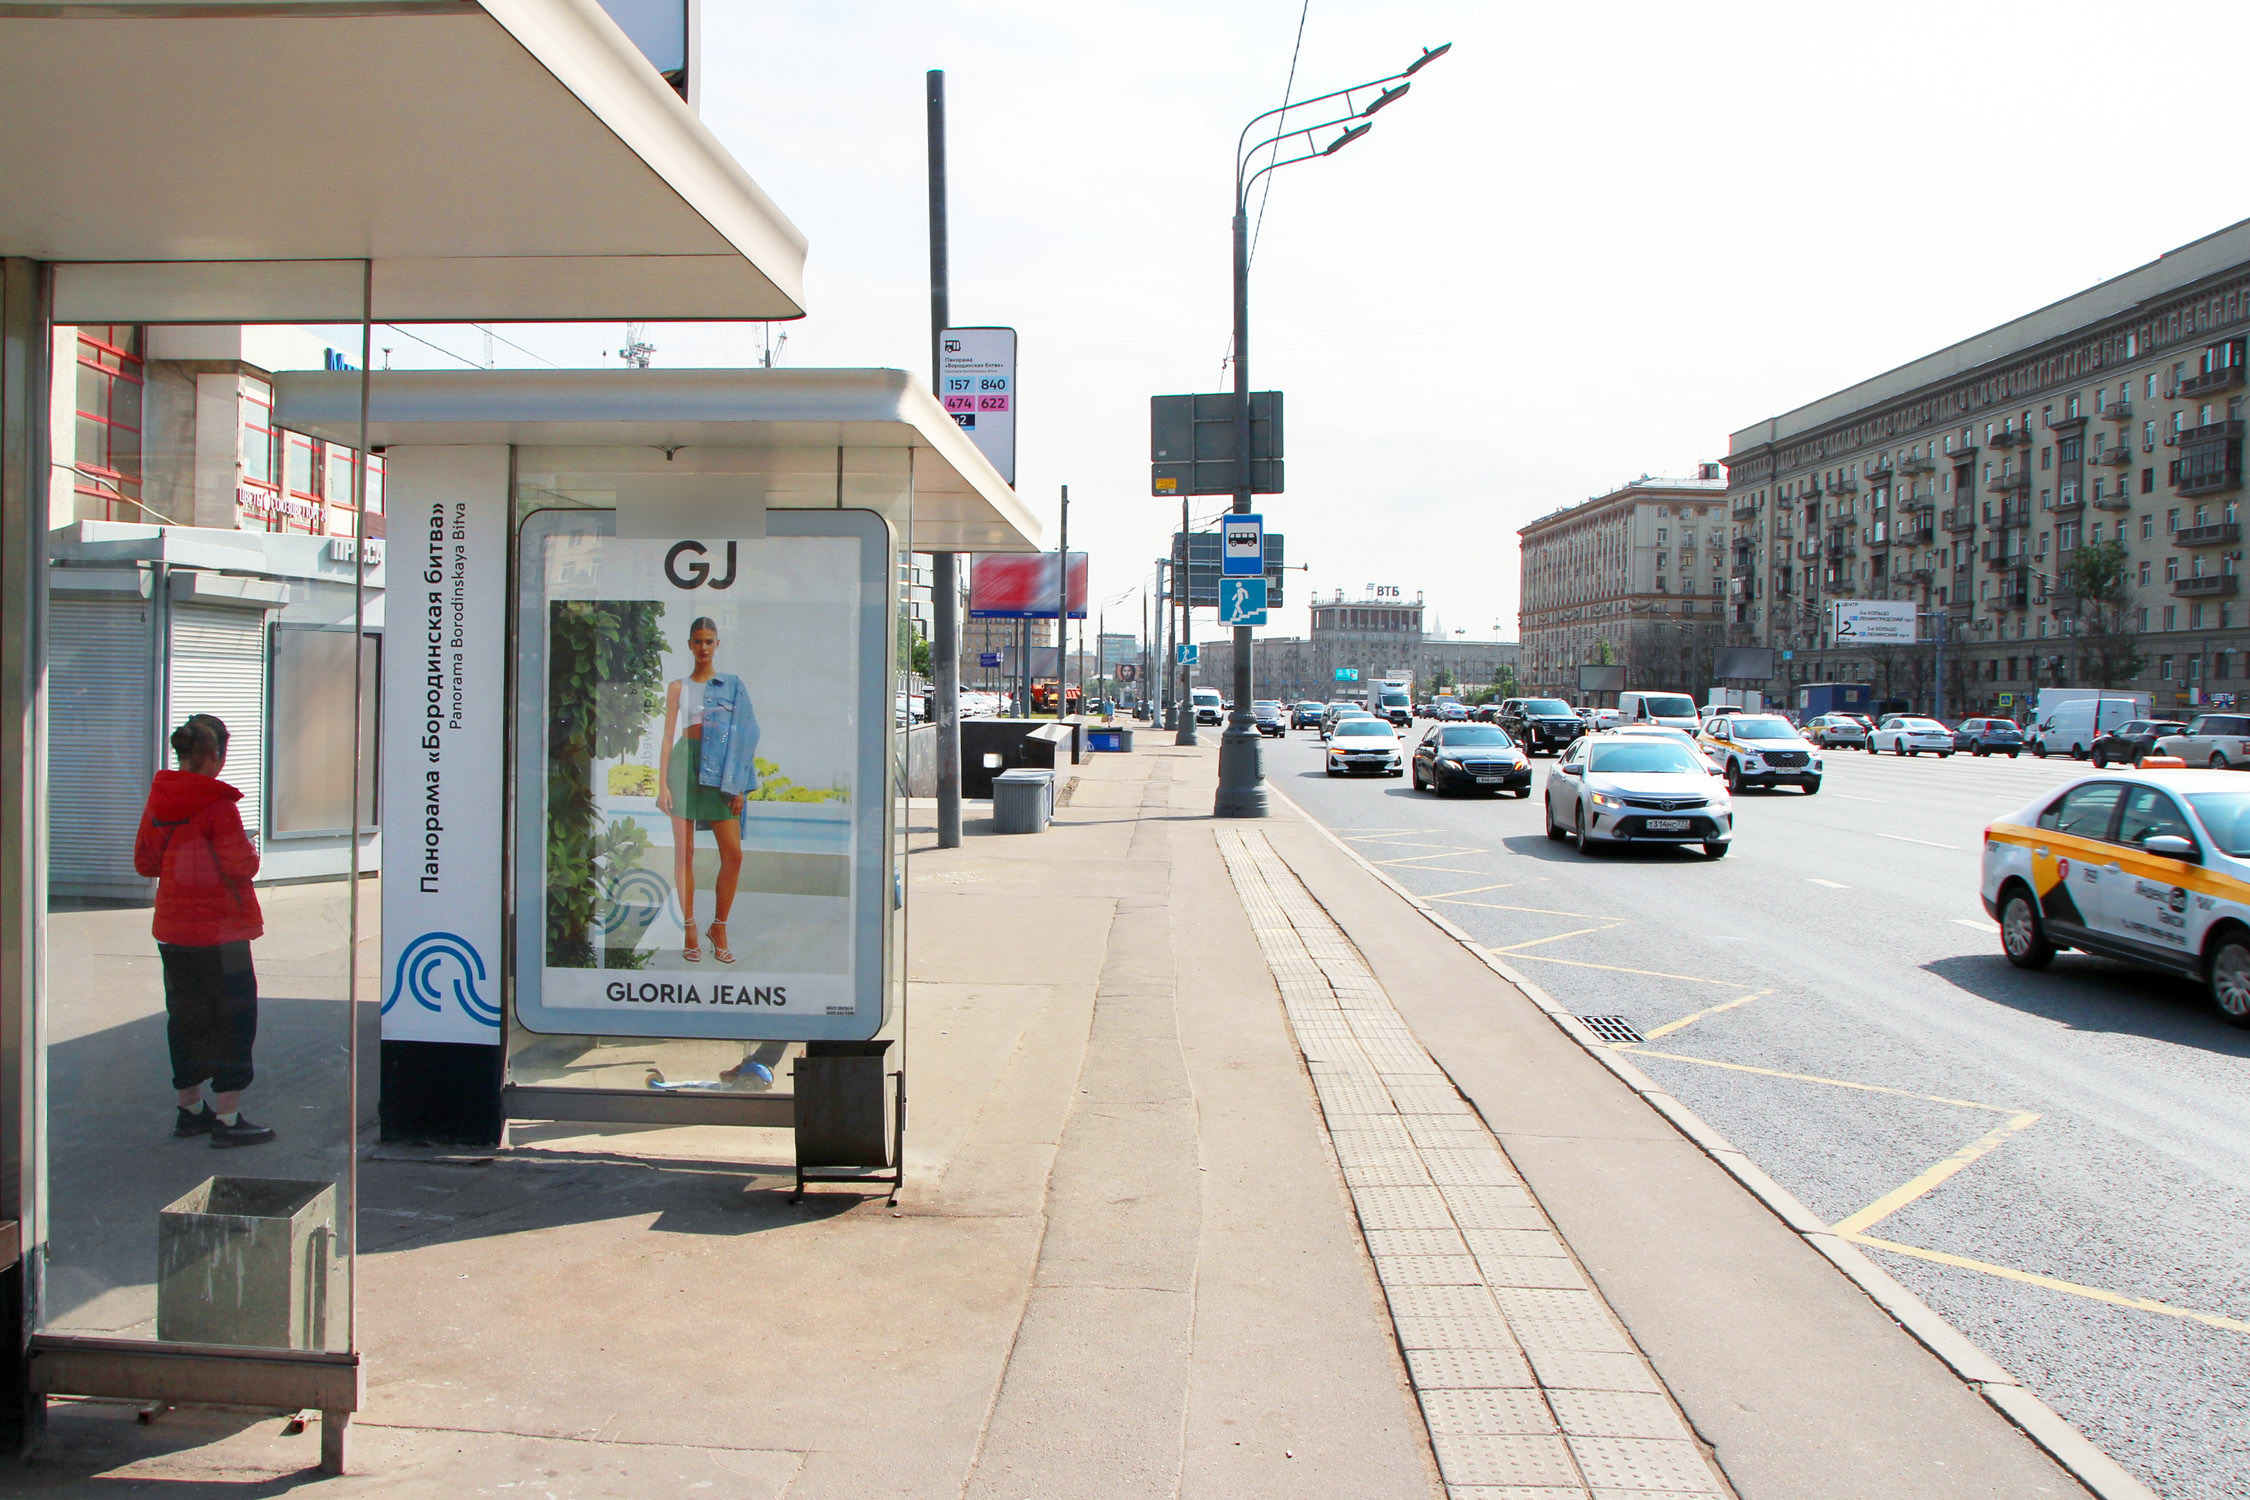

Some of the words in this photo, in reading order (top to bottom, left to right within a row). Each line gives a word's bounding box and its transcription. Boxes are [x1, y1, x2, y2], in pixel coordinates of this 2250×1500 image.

[948, 398, 972, 409] 474
[981, 398, 1005, 409] 622
[949, 379, 970, 391] 157
[981, 379, 1006, 390] 840
[237, 488, 263, 507] ЦВЕТЫ
[452, 502, 466, 540] Bitva
[423, 502, 444, 584] битва»
[664, 540, 737, 590] GJ
[450, 545, 468, 648] Borodinskaya
[1377, 586, 1400, 596] ВТБ
[421, 592, 445, 763] «Бородинская
[449, 653, 463, 729] Panorama
[2211, 692, 2235, 701] ЦВЕТЫ
[420, 770, 444, 893] Панорама
[606, 981, 702, 1004] GLORIA
[709, 985, 787, 1007] JEANS
